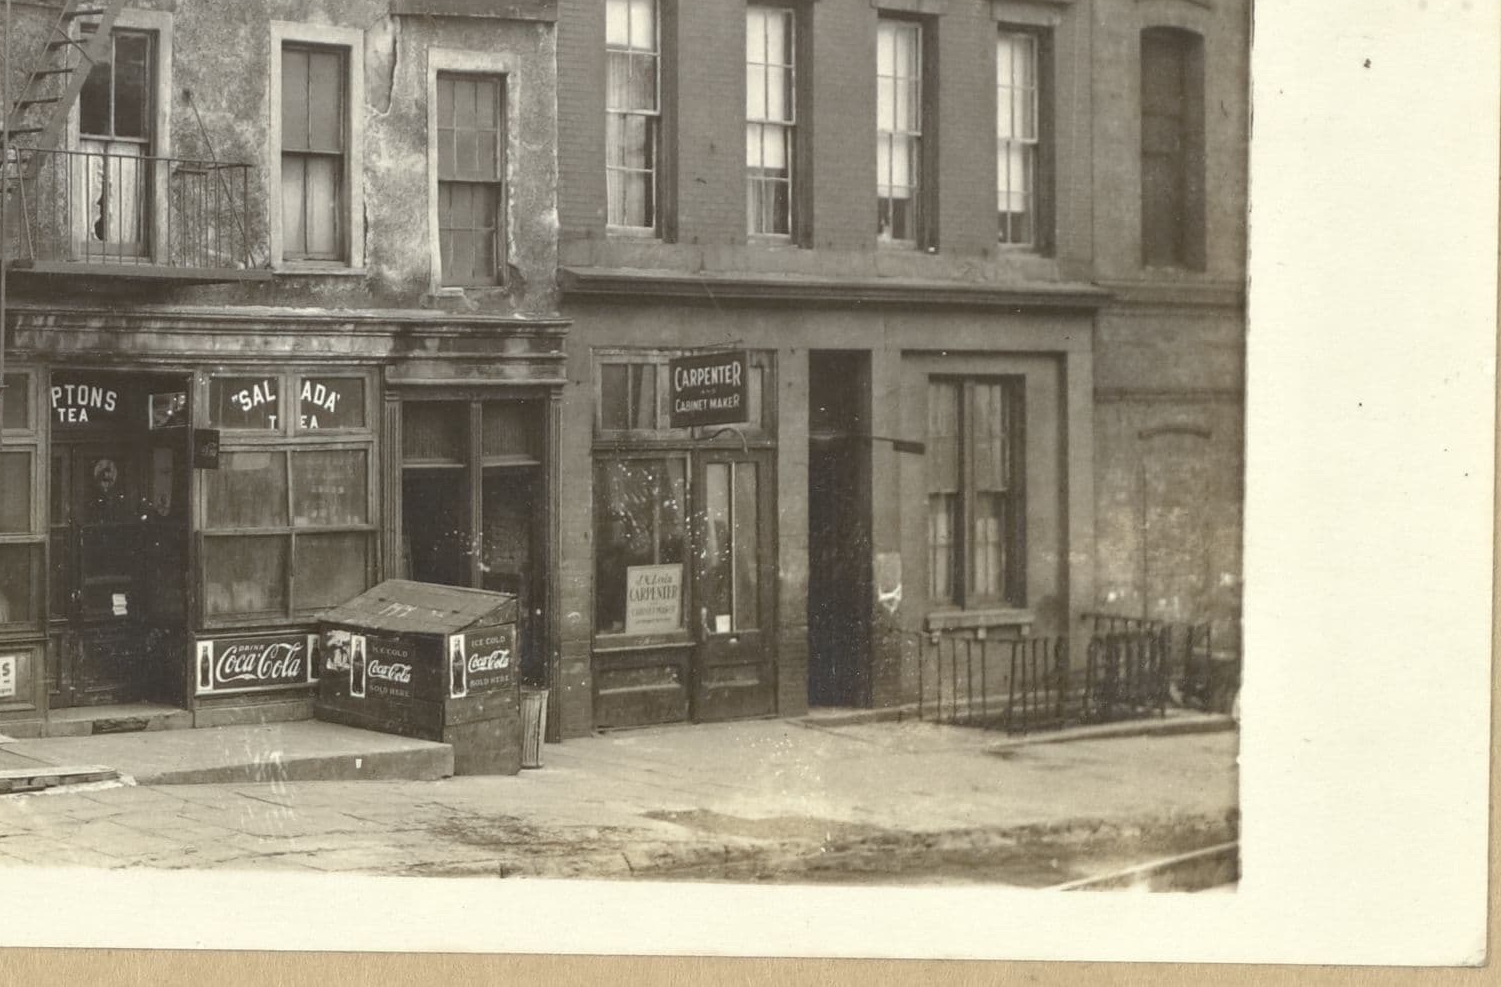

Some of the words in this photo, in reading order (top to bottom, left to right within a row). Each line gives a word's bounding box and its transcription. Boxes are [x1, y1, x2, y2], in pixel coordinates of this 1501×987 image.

[674, 360, 742, 392] CARPENTER
[51, 384, 118, 412] PTONS
[675, 398, 708, 413] CABINET
[709, 393, 740, 409] MAKER
[57, 408, 89, 423] TEA
[629, 585, 678, 602] CARPENTER
[238, 644, 265, 652] DRINK
[471, 639, 483, 648] ICE
[485, 635, 506, 645] COLD
[216, 641, 304, 682] Coca-Cola
[387, 648, 408, 657] COLD
[468, 648, 511, 673] Coca-Cola
[368, 659, 412, 683] Coca-Cola
[469, 677, 489, 687] SOLD
[490, 674, 509, 684] HERE
